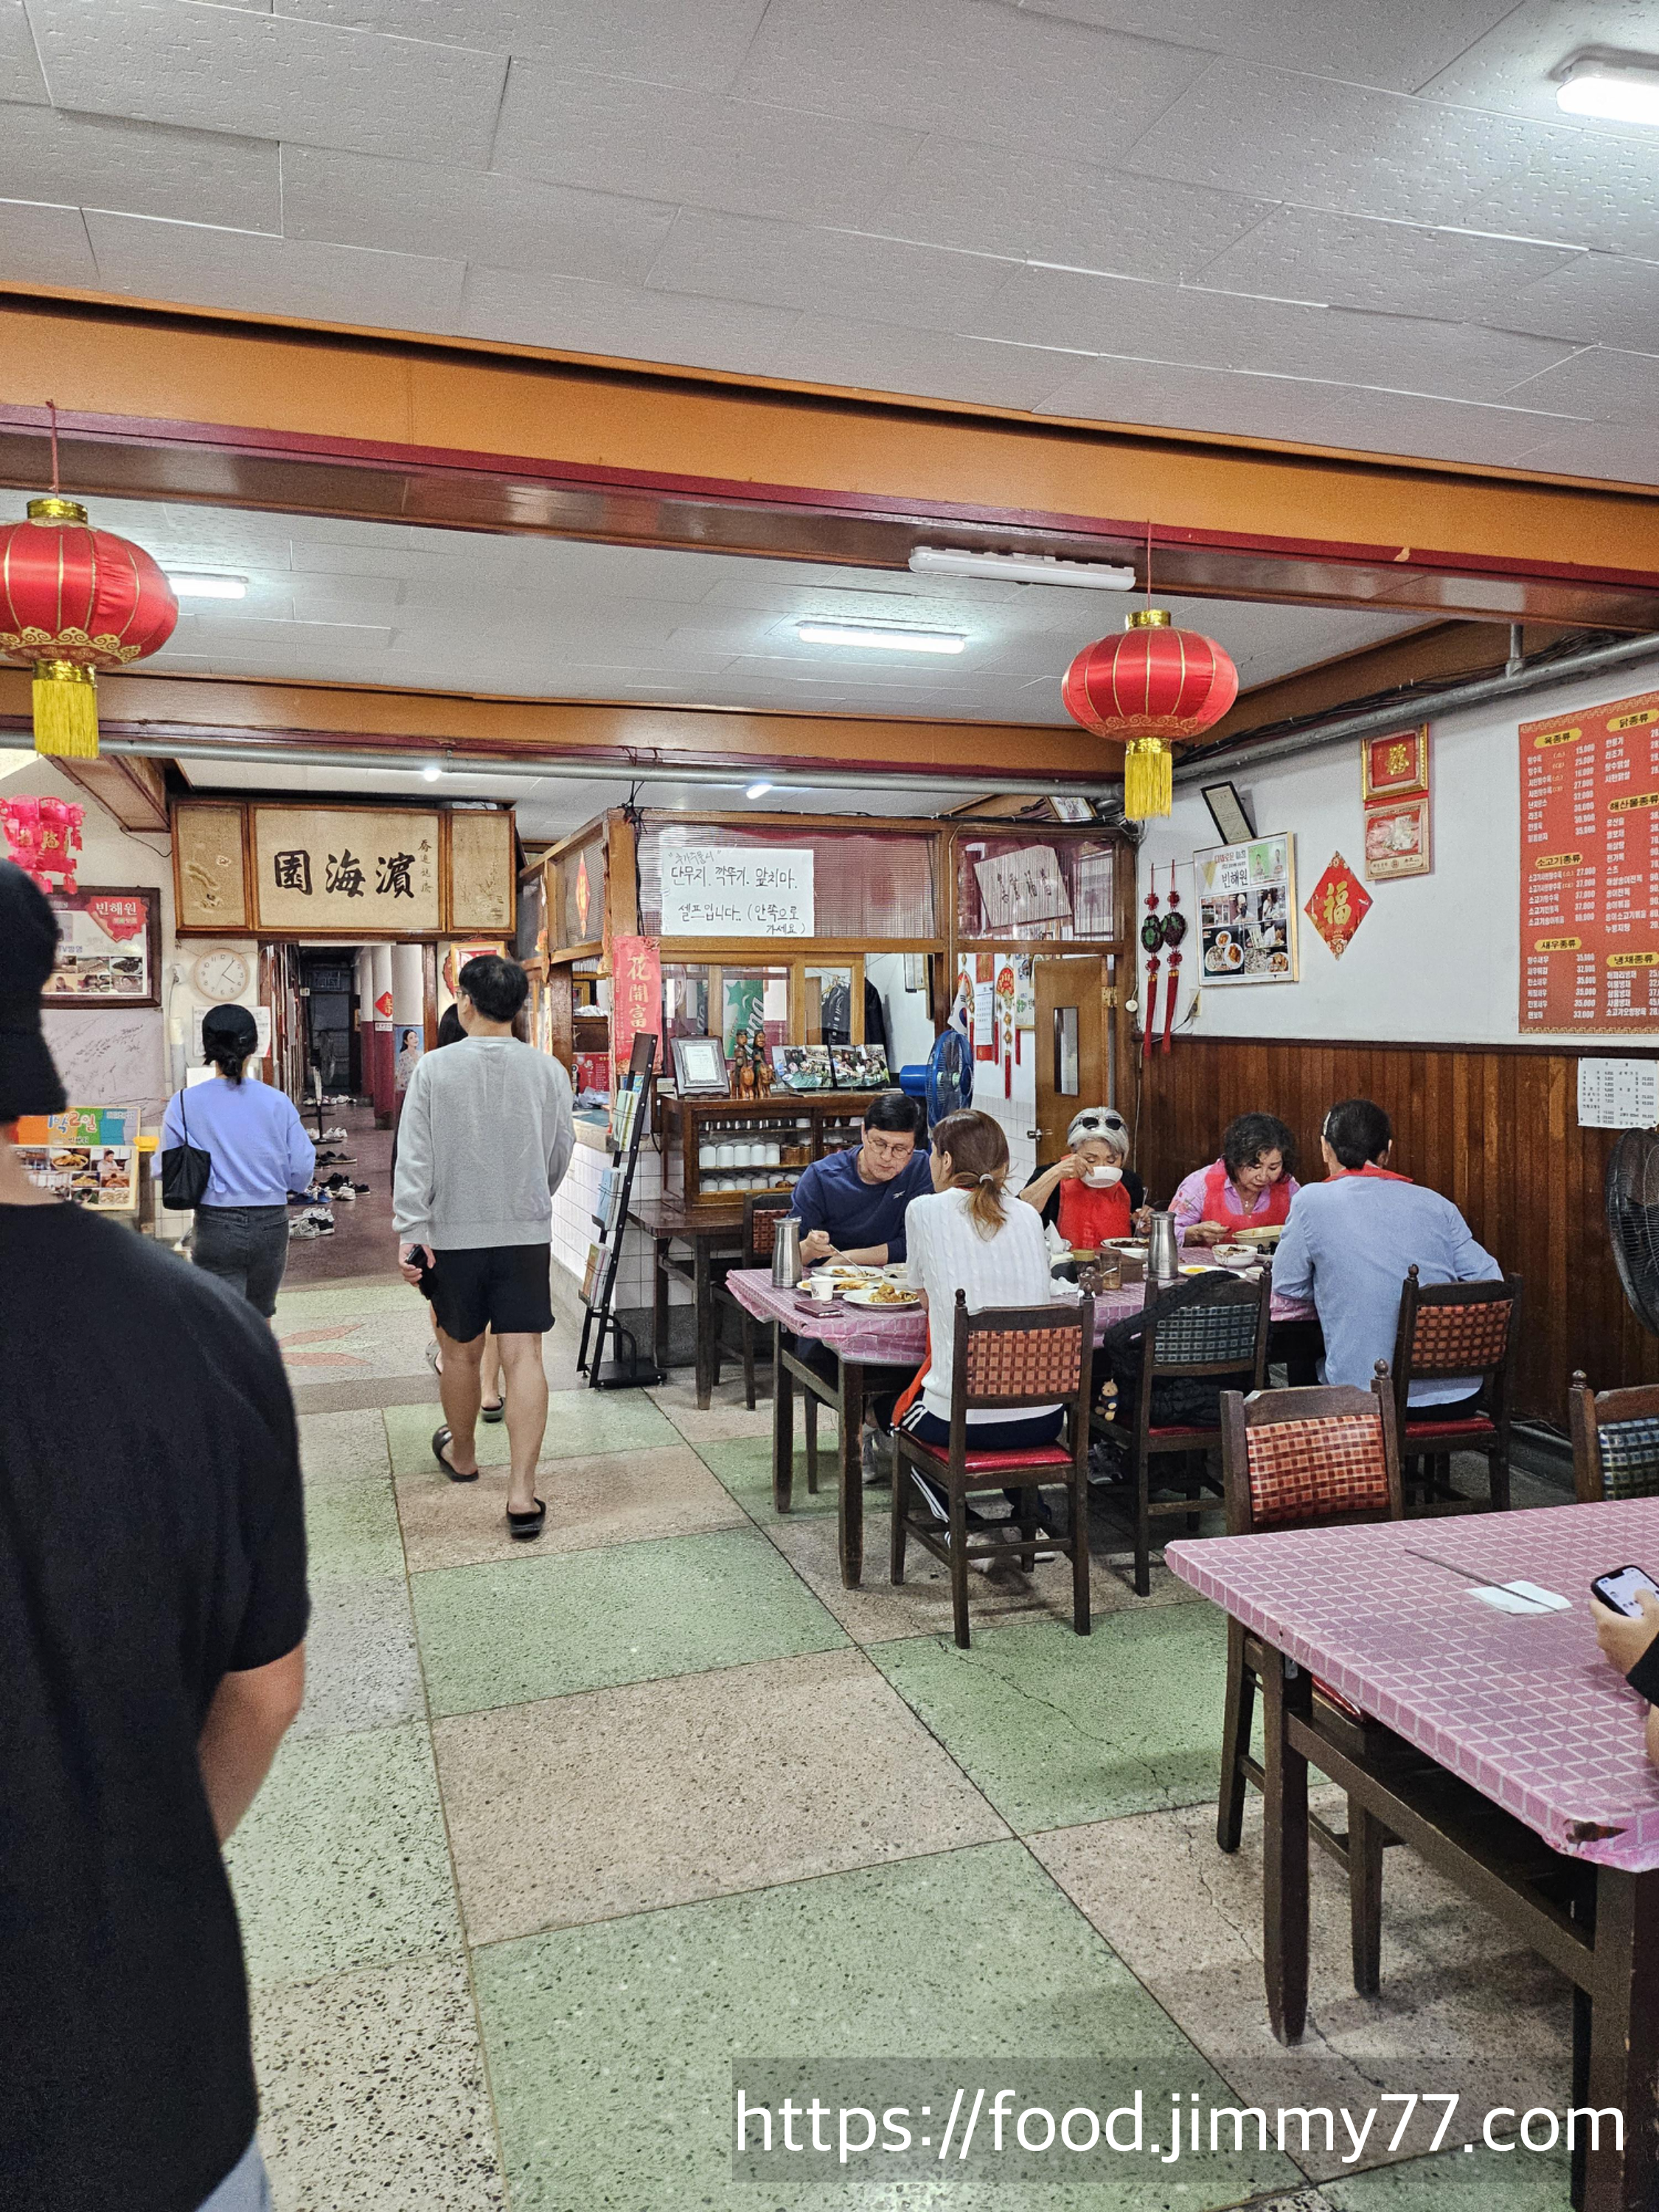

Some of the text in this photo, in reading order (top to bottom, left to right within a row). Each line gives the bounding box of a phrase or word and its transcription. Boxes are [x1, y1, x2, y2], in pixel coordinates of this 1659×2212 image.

[1544, 732, 1571, 745] 육종류
[1610, 795, 1658, 810] 해산물종류
[1537, 855, 1581, 866] 소고기종류
[756, 867, 798, 889] 앞치마.
[1222, 868, 1248, 888] 빈해원
[96, 901, 137, 916] 빈해원
[1323, 880, 1352, 925] 福
[1541, 939, 1576, 949] 새우종류
[1614, 955, 1653, 965] 냉채종류
[627, 953, 652, 1043] 花開富
[47, 1112, 97, 1133] 1박2일
